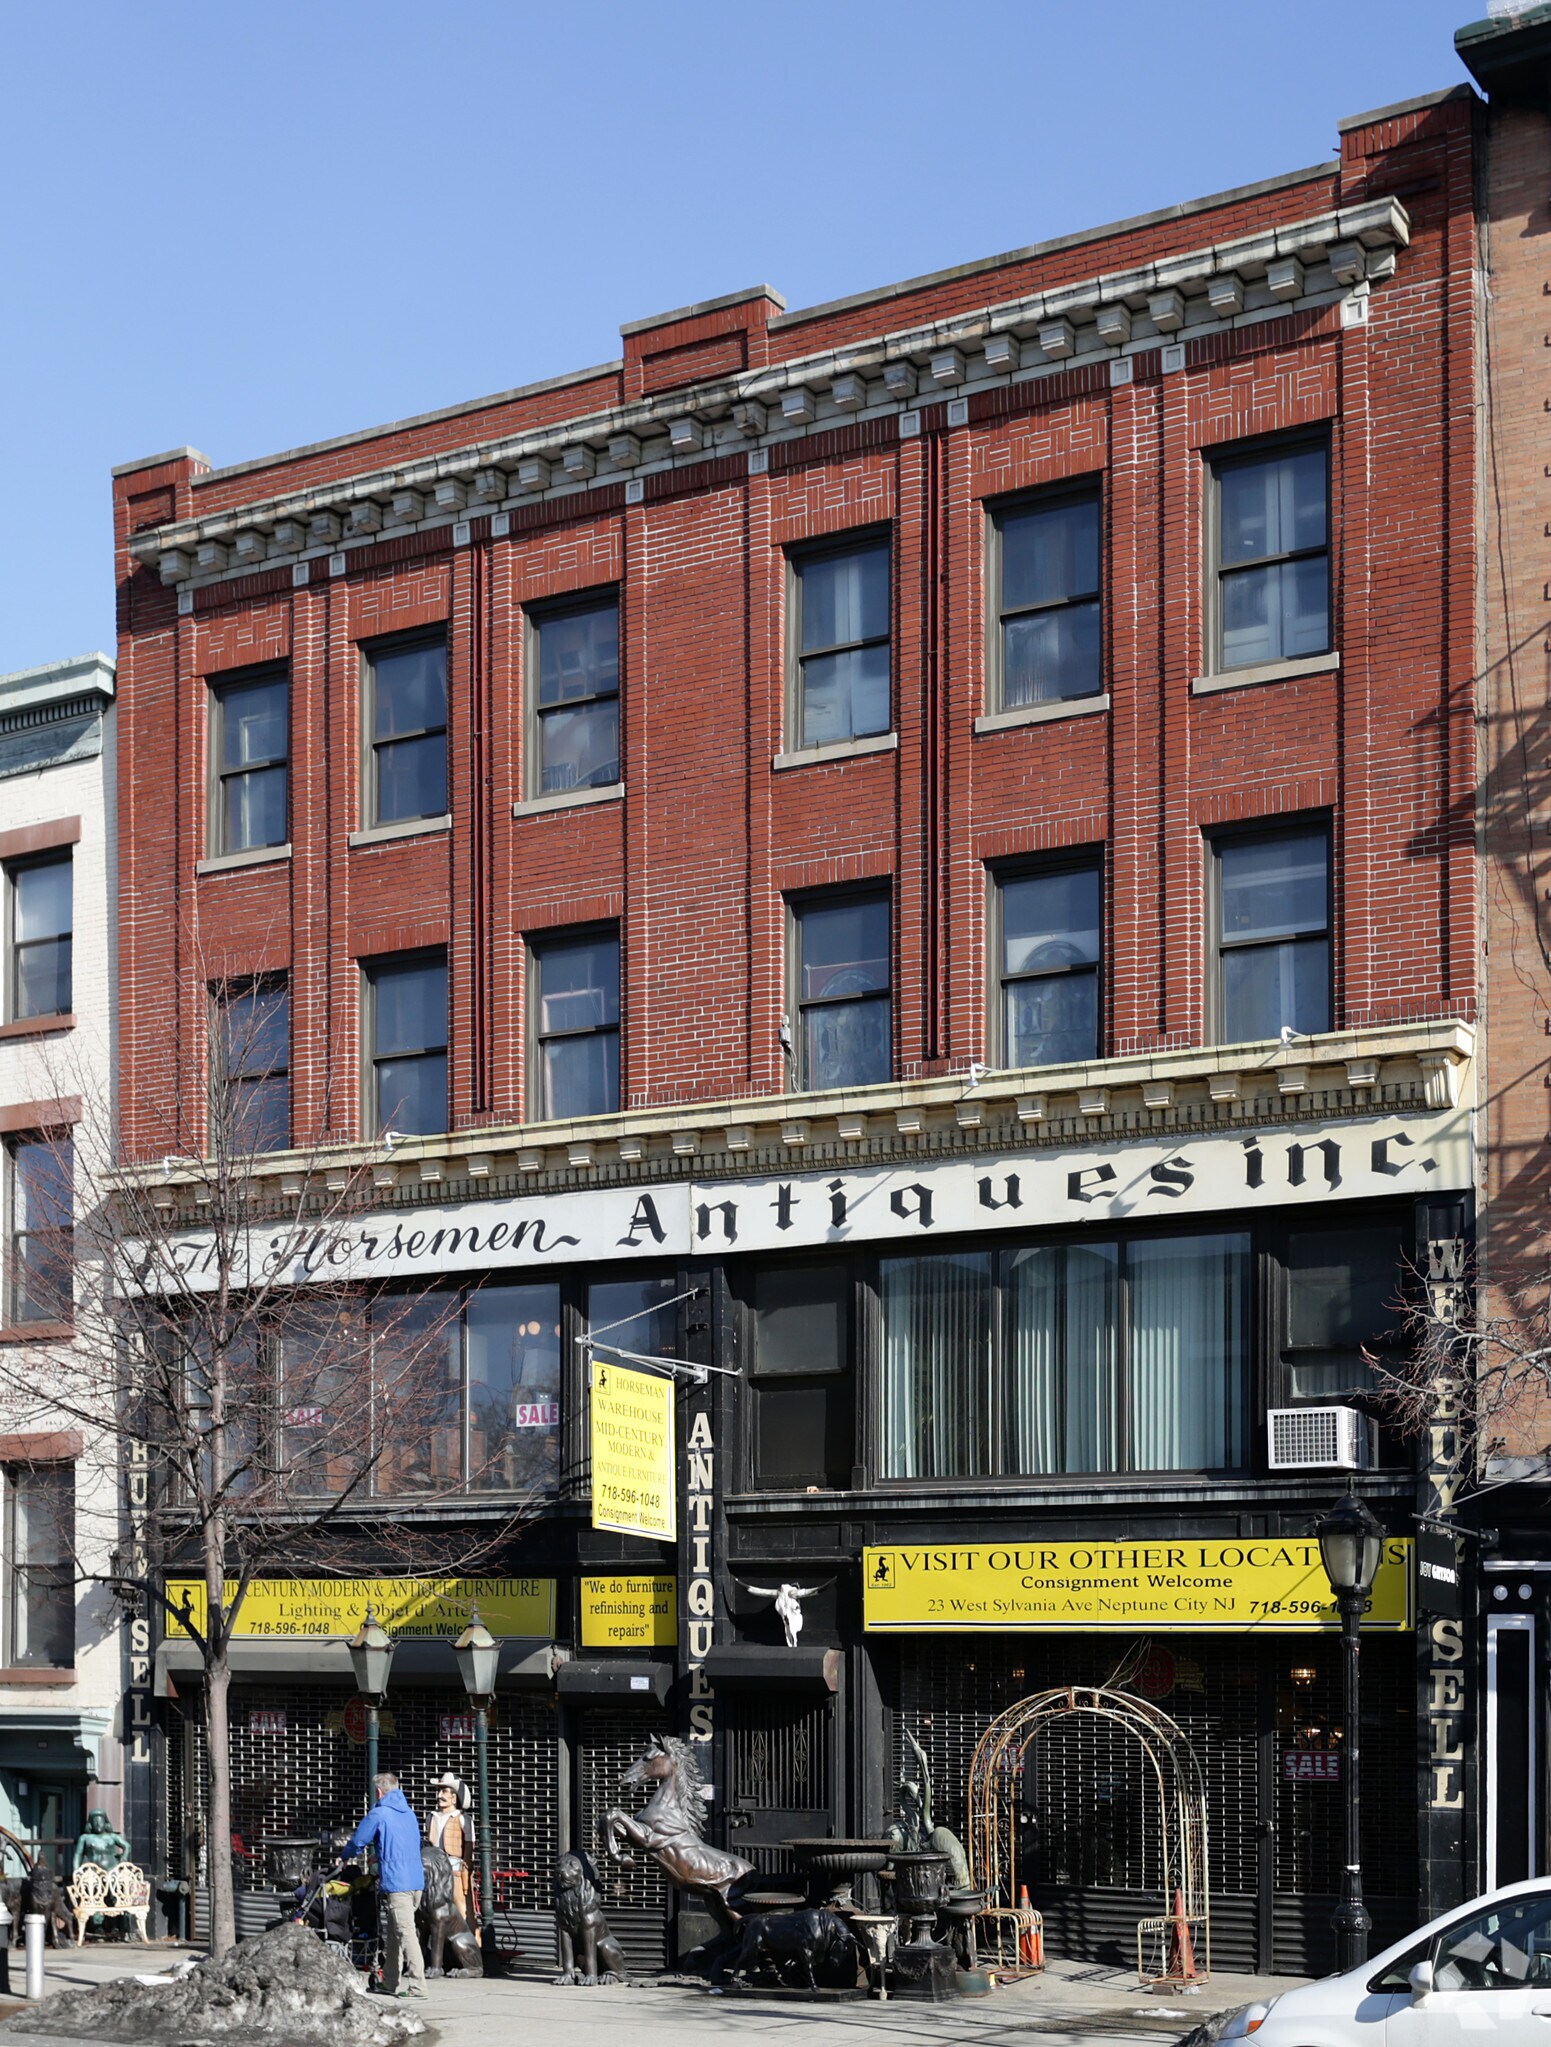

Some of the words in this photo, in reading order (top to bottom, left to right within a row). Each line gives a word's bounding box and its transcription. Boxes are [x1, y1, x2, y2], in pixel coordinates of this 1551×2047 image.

[170, 1241, 250, 1275] The
[262, 1217, 581, 1277] Horsemen
[616, 1156, 1195, 1248] Antiques
[1240, 1135, 1441, 1193] inc.
[616, 1377, 665, 1399] HORSEMAN
[519, 1404, 558, 1425] SALE
[597, 1398, 665, 1425] WAREHOUSE
[607, 1440, 648, 1459] MODERN
[648, 1449, 656, 1462] &
[1429, 1376, 1465, 1515] BUY
[597, 1461, 627, 1478] ANTIQUE
[628, 1466, 668, 1485] FURNITURE
[601, 1483, 661, 1509] 718-596-1048
[597, 1503, 638, 1524] Consignment
[639, 1512, 666, 1529] Welcome
[901, 1551, 980, 1572] VISIT
[988, 1550, 1061, 1571] OUR
[1069, 1548, 1188, 1571] OTHER
[1199, 1544, 1407, 1569] LOCATS
[584, 1580, 606, 1594] "We
[609, 1580, 623, 1594] do
[626, 1579, 673, 1594] furniture
[687, 1411, 715, 1742] ANTIQUES
[1021, 1576, 1139, 1592] Consignment
[1146, 1575, 1233, 1588] Welcome
[374, 1580, 385, 1598] &
[388, 1579, 452, 1598] ANTIQUE
[455, 1579, 541, 1598] FURNITURE
[279, 1602, 342, 1621] Lighting
[346, 1602, 361, 1617] &
[366, 1602, 410, 1621] Objet
[590, 1600, 646, 1618] refinishing
[648, 1600, 669, 1614] and
[927, 1599, 945, 1612] 23
[950, 1599, 988, 1612] West
[992, 1598, 1056, 1615] Sylvania
[1061, 1599, 1094, 1612] Ave
[1098, 1598, 1169, 1616] Neptune
[1173, 1596, 1208, 1614] City
[1213, 1597, 1236, 1612] NJ
[1249, 1600, 1374, 1614] 718-596-18
[250, 1622, 330, 1635] 718-596-1048
[608, 1623, 650, 1641] repairs"
[130, 1618, 151, 1763] SELL
[1430, 1618, 1465, 1810] SELL
[1285, 1755, 1338, 1776] SALE
